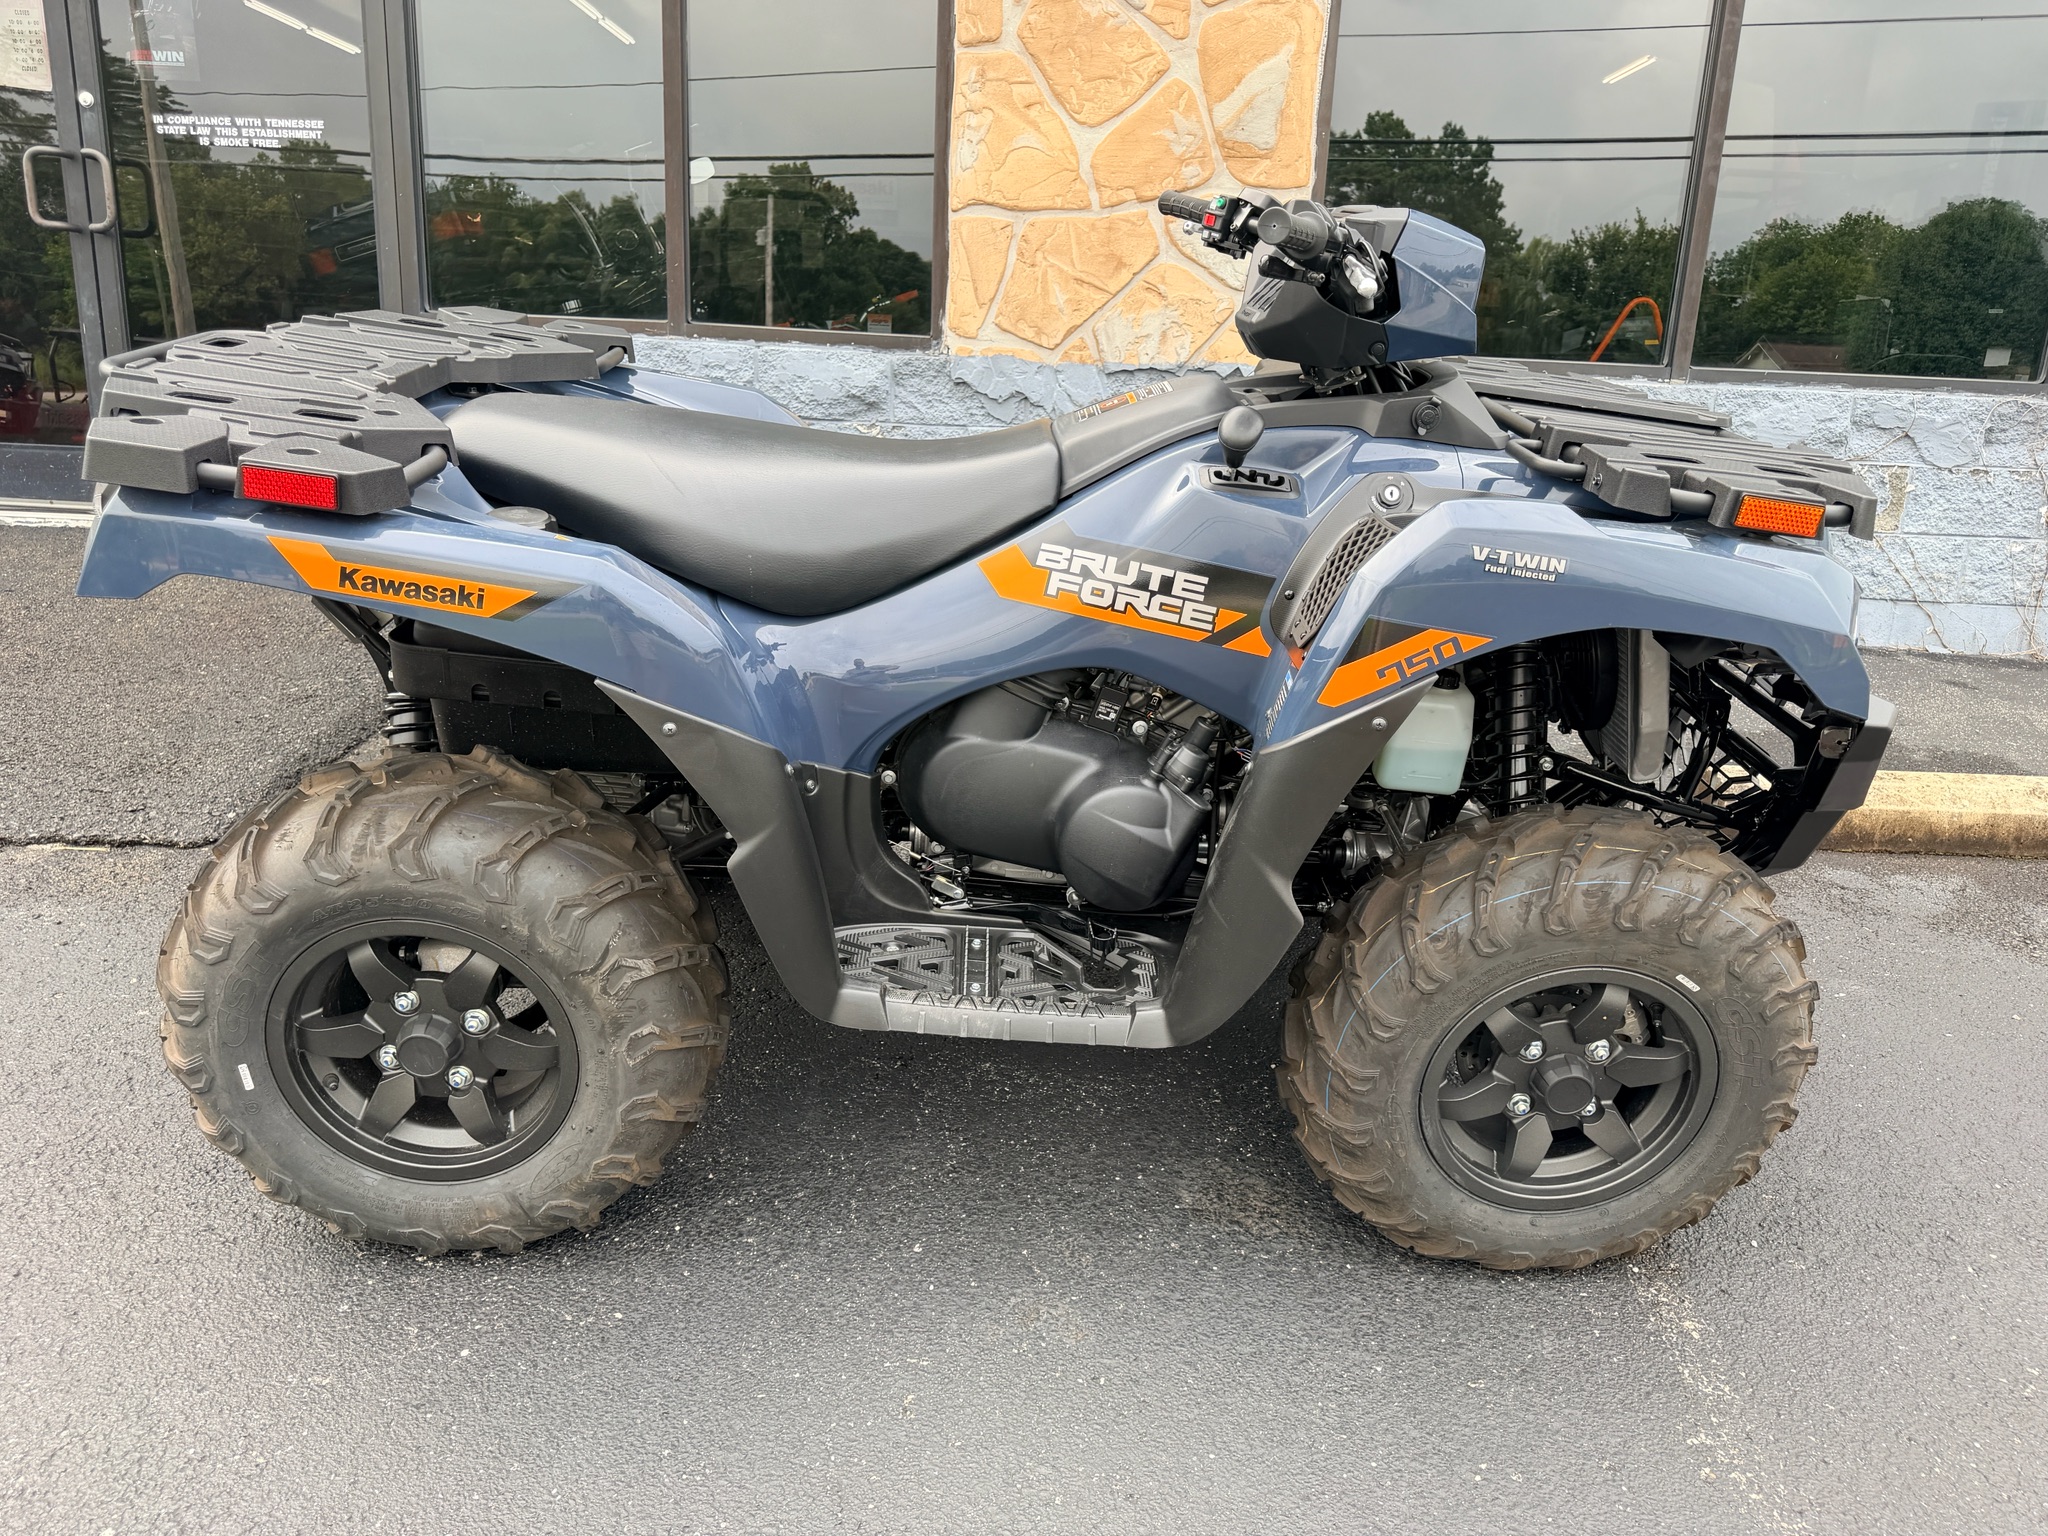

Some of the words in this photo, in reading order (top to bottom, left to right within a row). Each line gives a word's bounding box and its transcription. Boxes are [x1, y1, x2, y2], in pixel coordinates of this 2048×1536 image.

[152, 50, 184, 62] WIN
[152, 114, 164, 124] IN
[167, 115, 232, 126] COMPLIANCE
[234, 117, 261, 127] WITH
[265, 118, 325, 129] TENNESSEE
[156, 125, 187, 135] STATE
[190, 126, 211, 136] LAW
[215, 127, 238, 136] THIS
[241, 128, 322, 139] ESTABLISHMENT
[199, 136, 210, 146] IS
[213, 137, 249, 147] SMOKE
[252, 138, 282, 148] FREE.
[1035, 542, 1210, 602] BRUTE
[1472, 545, 1567, 574] V-TWIN
[1484, 563, 1507, 574] Fuel
[1511, 568, 1556, 582] Injected
[338, 565, 485, 610] Kawasaki
[1046, 570, 1218, 631] FORCE
[1376, 636, 1463, 681] 750
[216, 939, 274, 1048] CST
[1715, 996, 1763, 1088] CST
